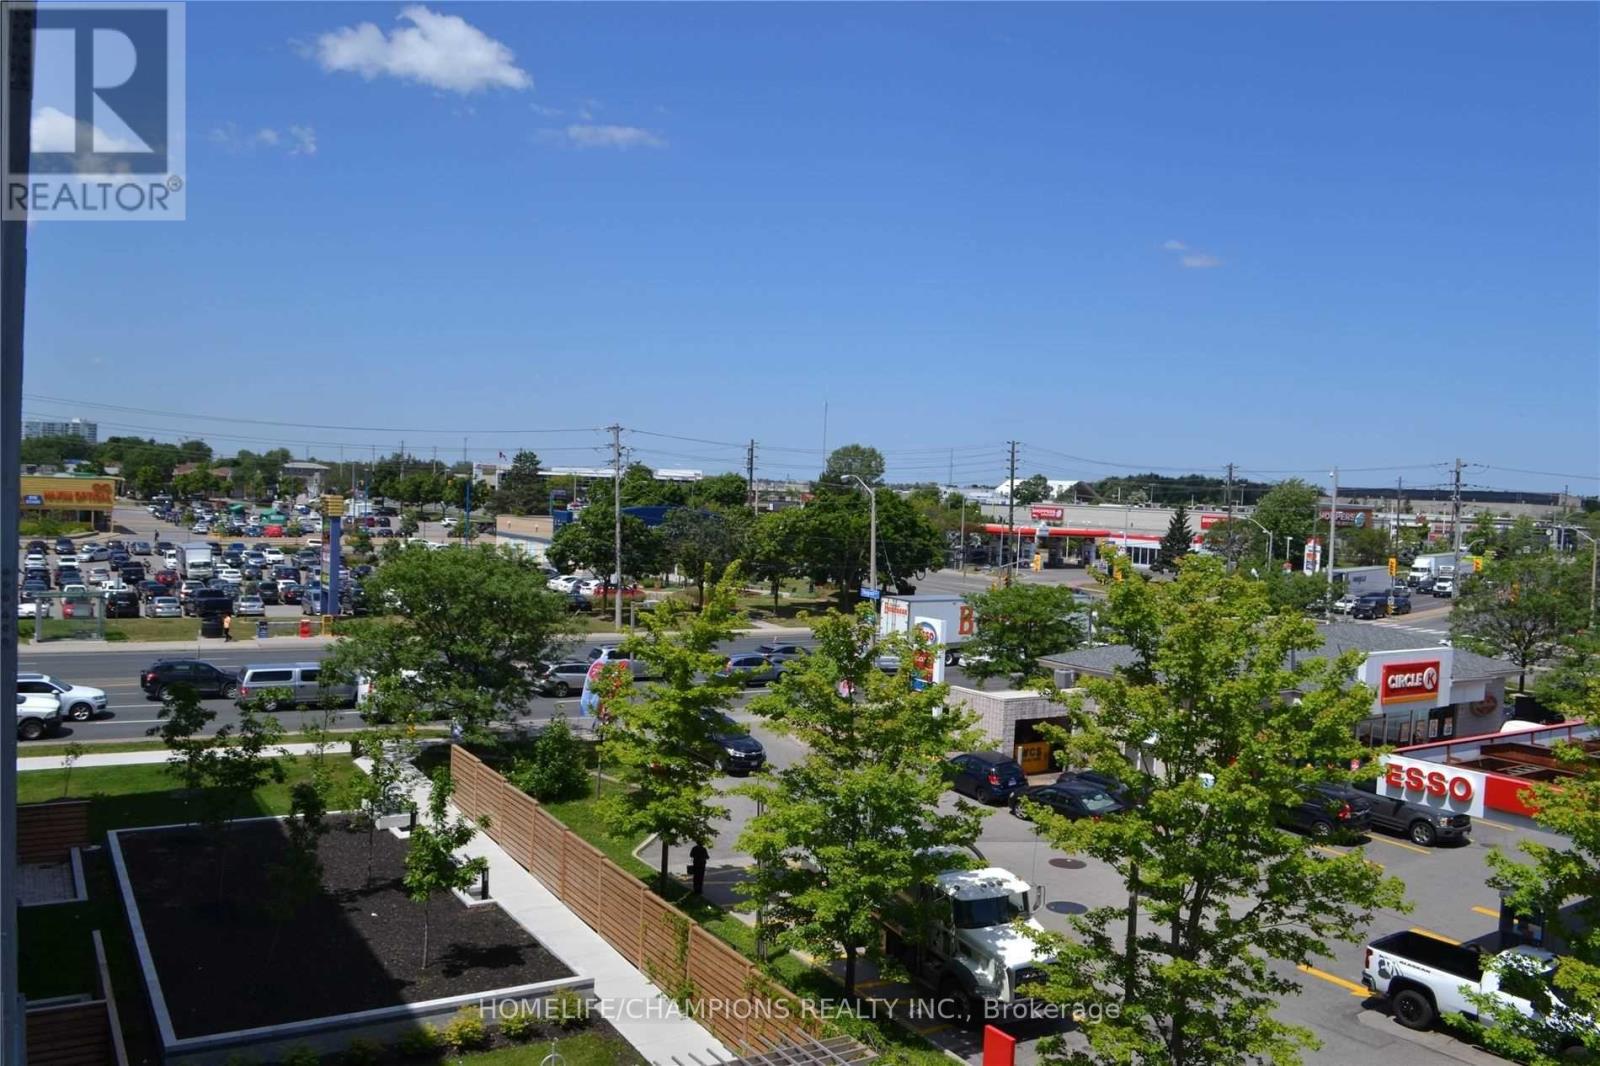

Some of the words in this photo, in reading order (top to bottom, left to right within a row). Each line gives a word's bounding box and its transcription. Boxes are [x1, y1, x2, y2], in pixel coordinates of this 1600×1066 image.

[1388, 673, 1423, 689] CIRCLE
[1424, 667, 1437, 690] K
[1386, 763, 1473, 802] ESSO
